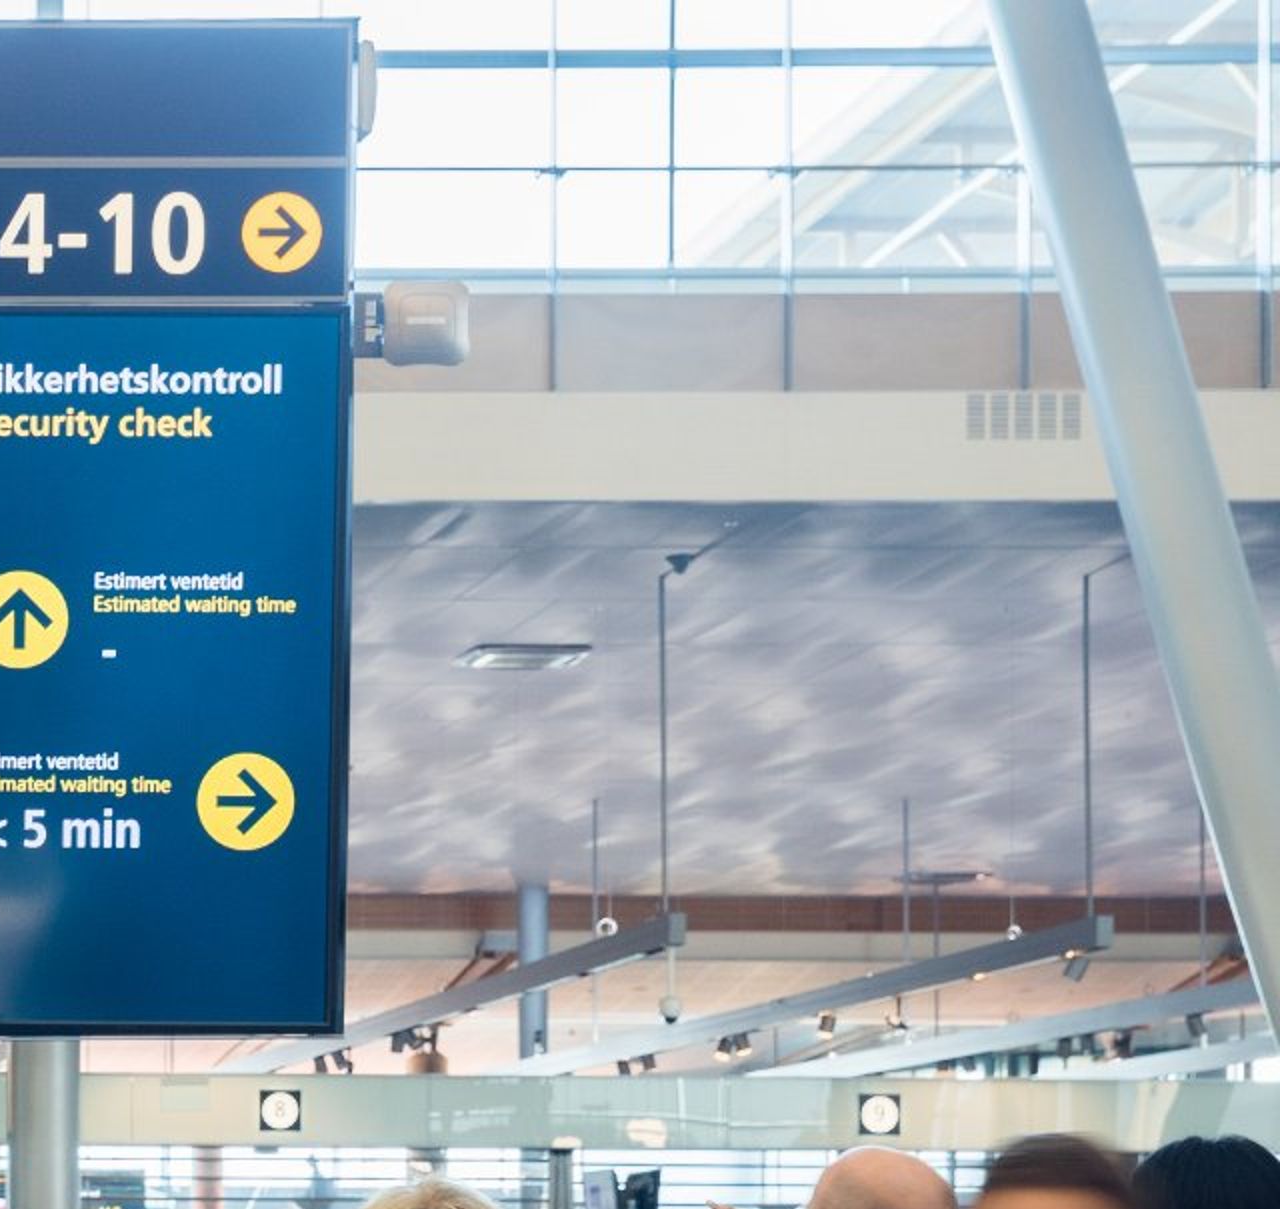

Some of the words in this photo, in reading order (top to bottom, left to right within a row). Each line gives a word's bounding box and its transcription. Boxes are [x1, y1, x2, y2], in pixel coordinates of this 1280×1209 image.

[119, 407, 212, 437] check
[95, 572, 166, 590] Estimert
[171, 572, 243, 590] ventetid
[94, 595, 180, 612] Estimated
[185, 596, 251, 616] waiting
[256, 596, 296, 613] time
[47, 753, 118, 770] ventetid
[60, 776, 126, 797] waiting
[132, 776, 171, 793] time
[24, 810, 46, 848] 5
[63, 808, 140, 848] min
